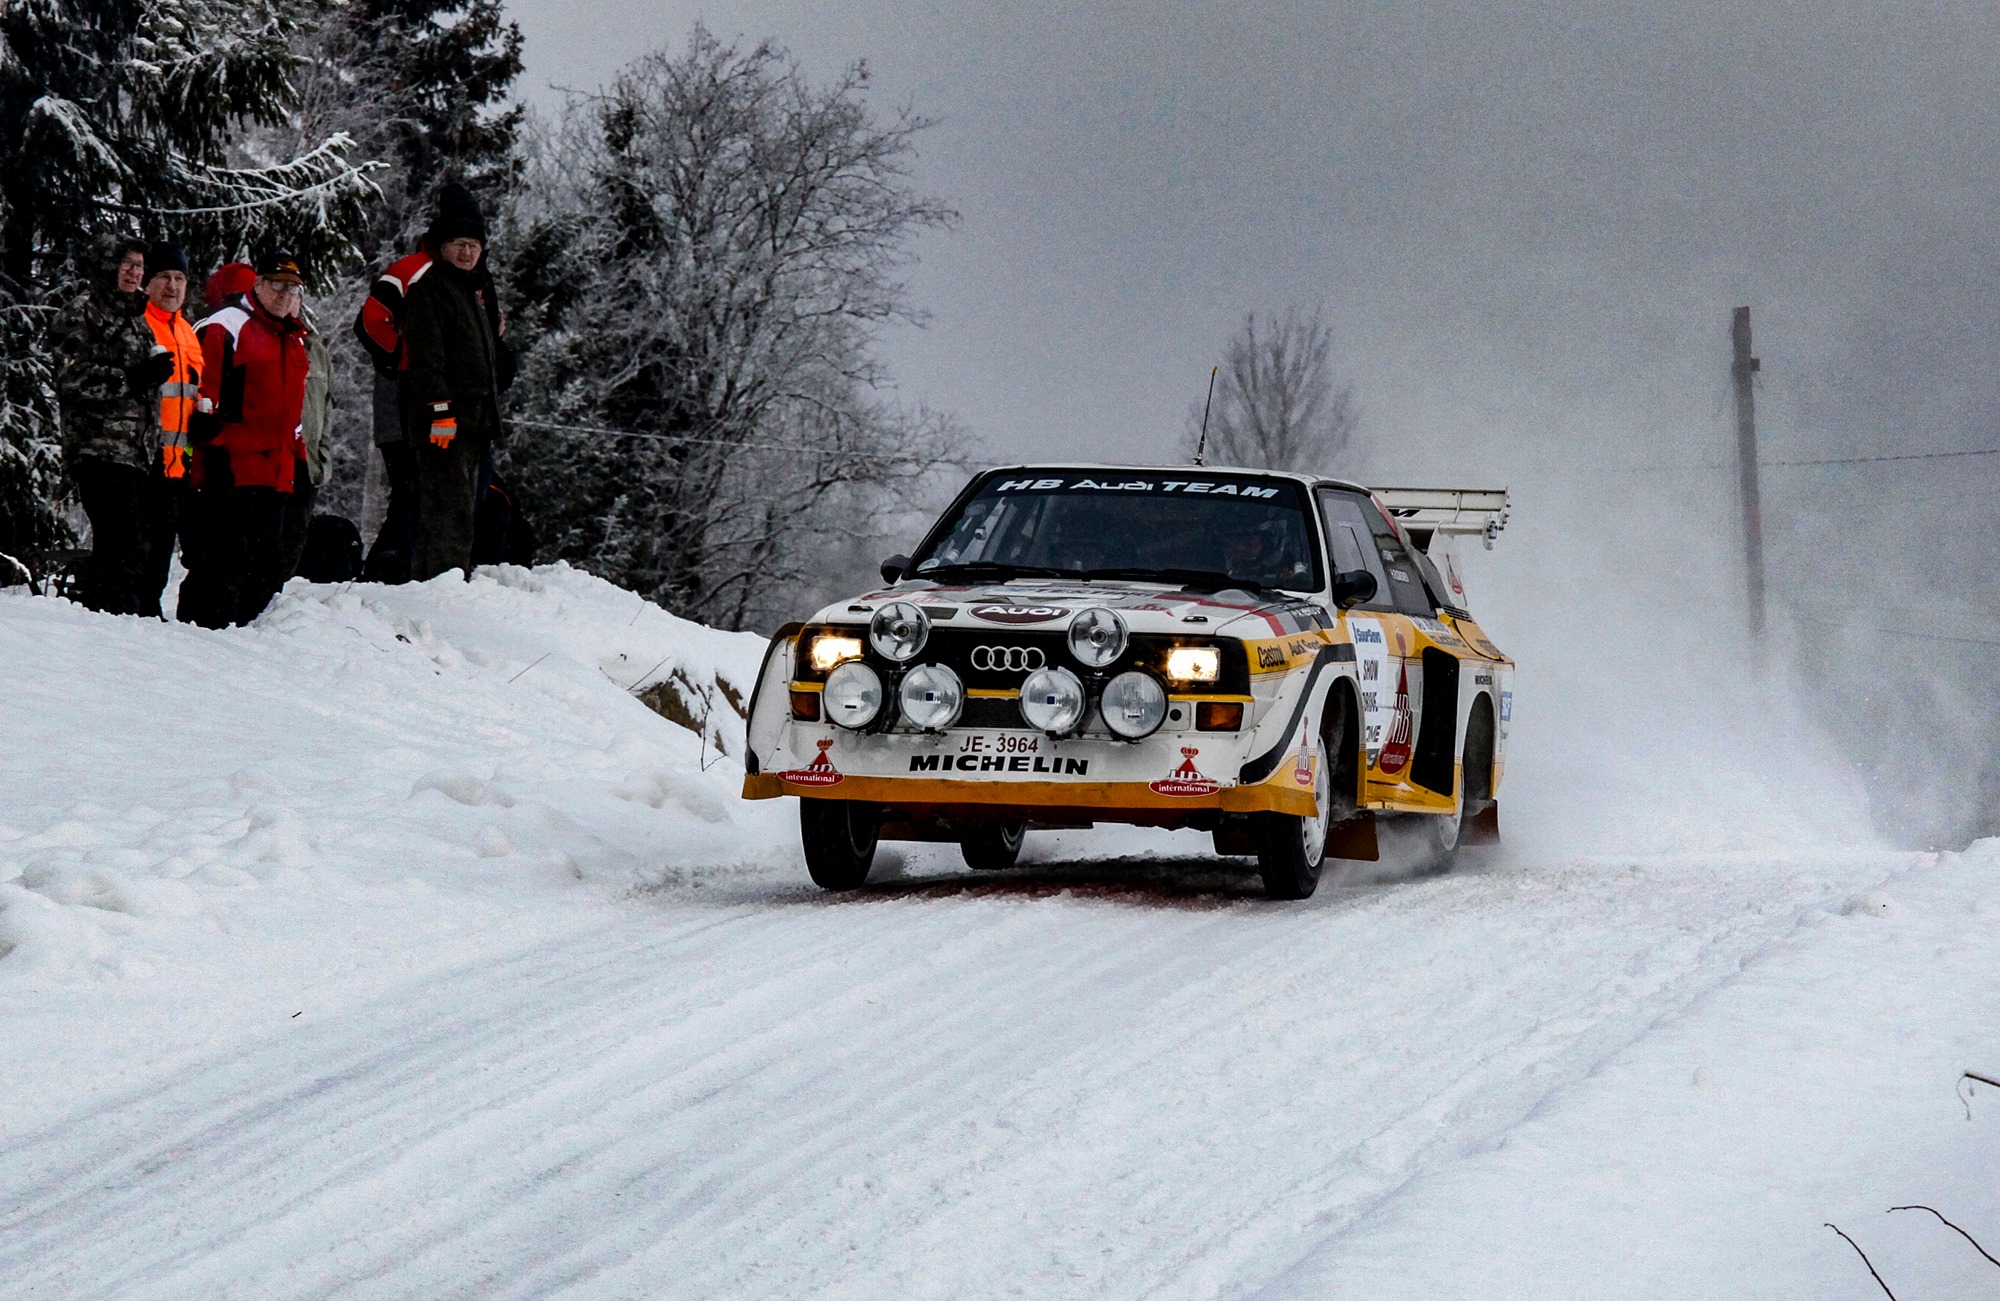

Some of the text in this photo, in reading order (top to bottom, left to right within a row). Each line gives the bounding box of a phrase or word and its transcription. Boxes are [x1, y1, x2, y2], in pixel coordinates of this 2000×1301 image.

[997, 479, 1280, 499] HB Audi TEAM
[1257, 644, 1286, 669] Castrol
[1363, 659, 1380, 681] SHOW
[1391, 692, 1411, 745] HB
[909, 754, 1090, 776] MICHELIN
[785, 772, 835, 783] international
[1158, 783, 1211, 793] international
